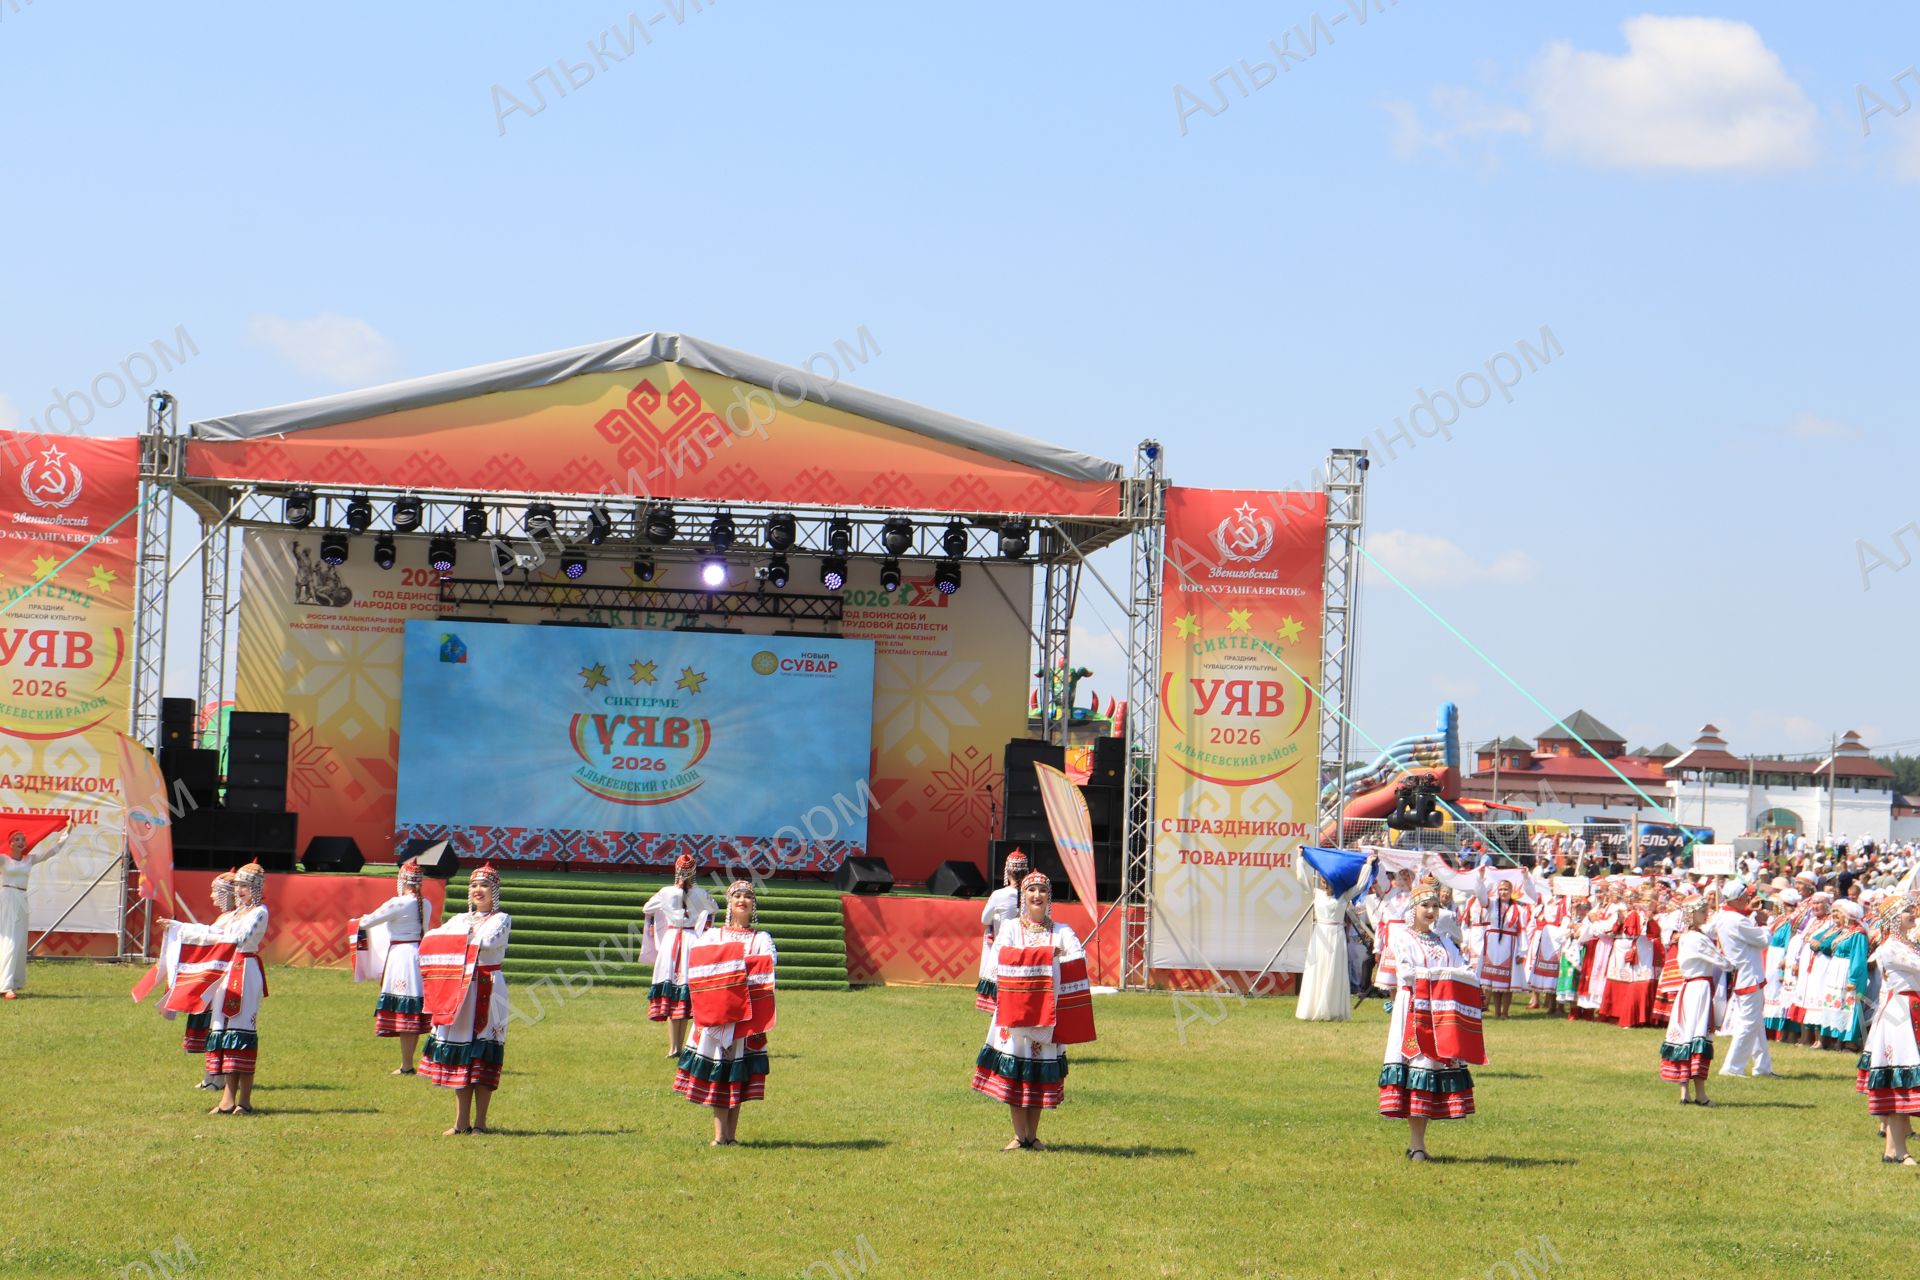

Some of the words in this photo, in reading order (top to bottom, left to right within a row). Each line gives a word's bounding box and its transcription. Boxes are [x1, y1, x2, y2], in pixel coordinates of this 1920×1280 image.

[12, 512, 88, 526] Звениговский
[8, 530, 119, 544] «ХУЗАНГАЕВСКОЕ»
[1208, 567, 1279, 580] Звениговский
[373, 591, 394, 600] ГОД
[397, 591, 454, 601] ЕДИНСТ
[1179, 583, 1203, 593] ООО
[1205, 584, 1306, 597] «ХУЗАНГАЕВСКОЕ»
[842, 590, 890, 607] 2026
[353, 600, 407, 611] НАРОДОВ
[410, 603, 454, 613] РОССИИ
[6, 612, 48, 620] ЧУВАШСКОЙ
[842, 610, 860, 619] ГОД
[863, 611, 916, 621] ВОИНСКОЙ
[919, 613, 926, 621] И
[842, 620, 893, 629] ТРУДОВОЙ
[896, 622, 948, 632] ДОБЛЕСТИ
[1192, 635, 1285, 659] СИКТЕРМЕ
[780, 659, 838, 672] СУВАР
[1224, 655, 1257, 663] ПРАЗДНИК
[1204, 663, 1243, 671] ЧУВАШСКОЙ
[12, 679, 67, 698] 2026
[604, 696, 679, 708] СИКТЕРМЕ
[1190, 678, 1285, 717] УЯВ
[66, 696, 107, 716] РАЙОН
[591, 713, 690, 755] УЯВ
[1210, 728, 1261, 745] 2026
[1174, 742, 1257, 767] АЛЬКЕЕВСКИЙ
[1260, 743, 1298, 764] РАЙОН
[612, 756, 667, 771] 2026
[0, 774, 120, 796] АЗДНИКОМ,
[576, 766, 657, 792] АЛЬКЕЕВСКИЙ
[661, 769, 700, 790] РАЙОН
[1161, 818, 1172, 833] С
[1175, 819, 1311, 839] ПРАЗДНИКОМ,
[1629, 834, 1684, 847] ЕЛЬТА
[1179, 850, 1291, 869] ТОВАРИЩИ!
